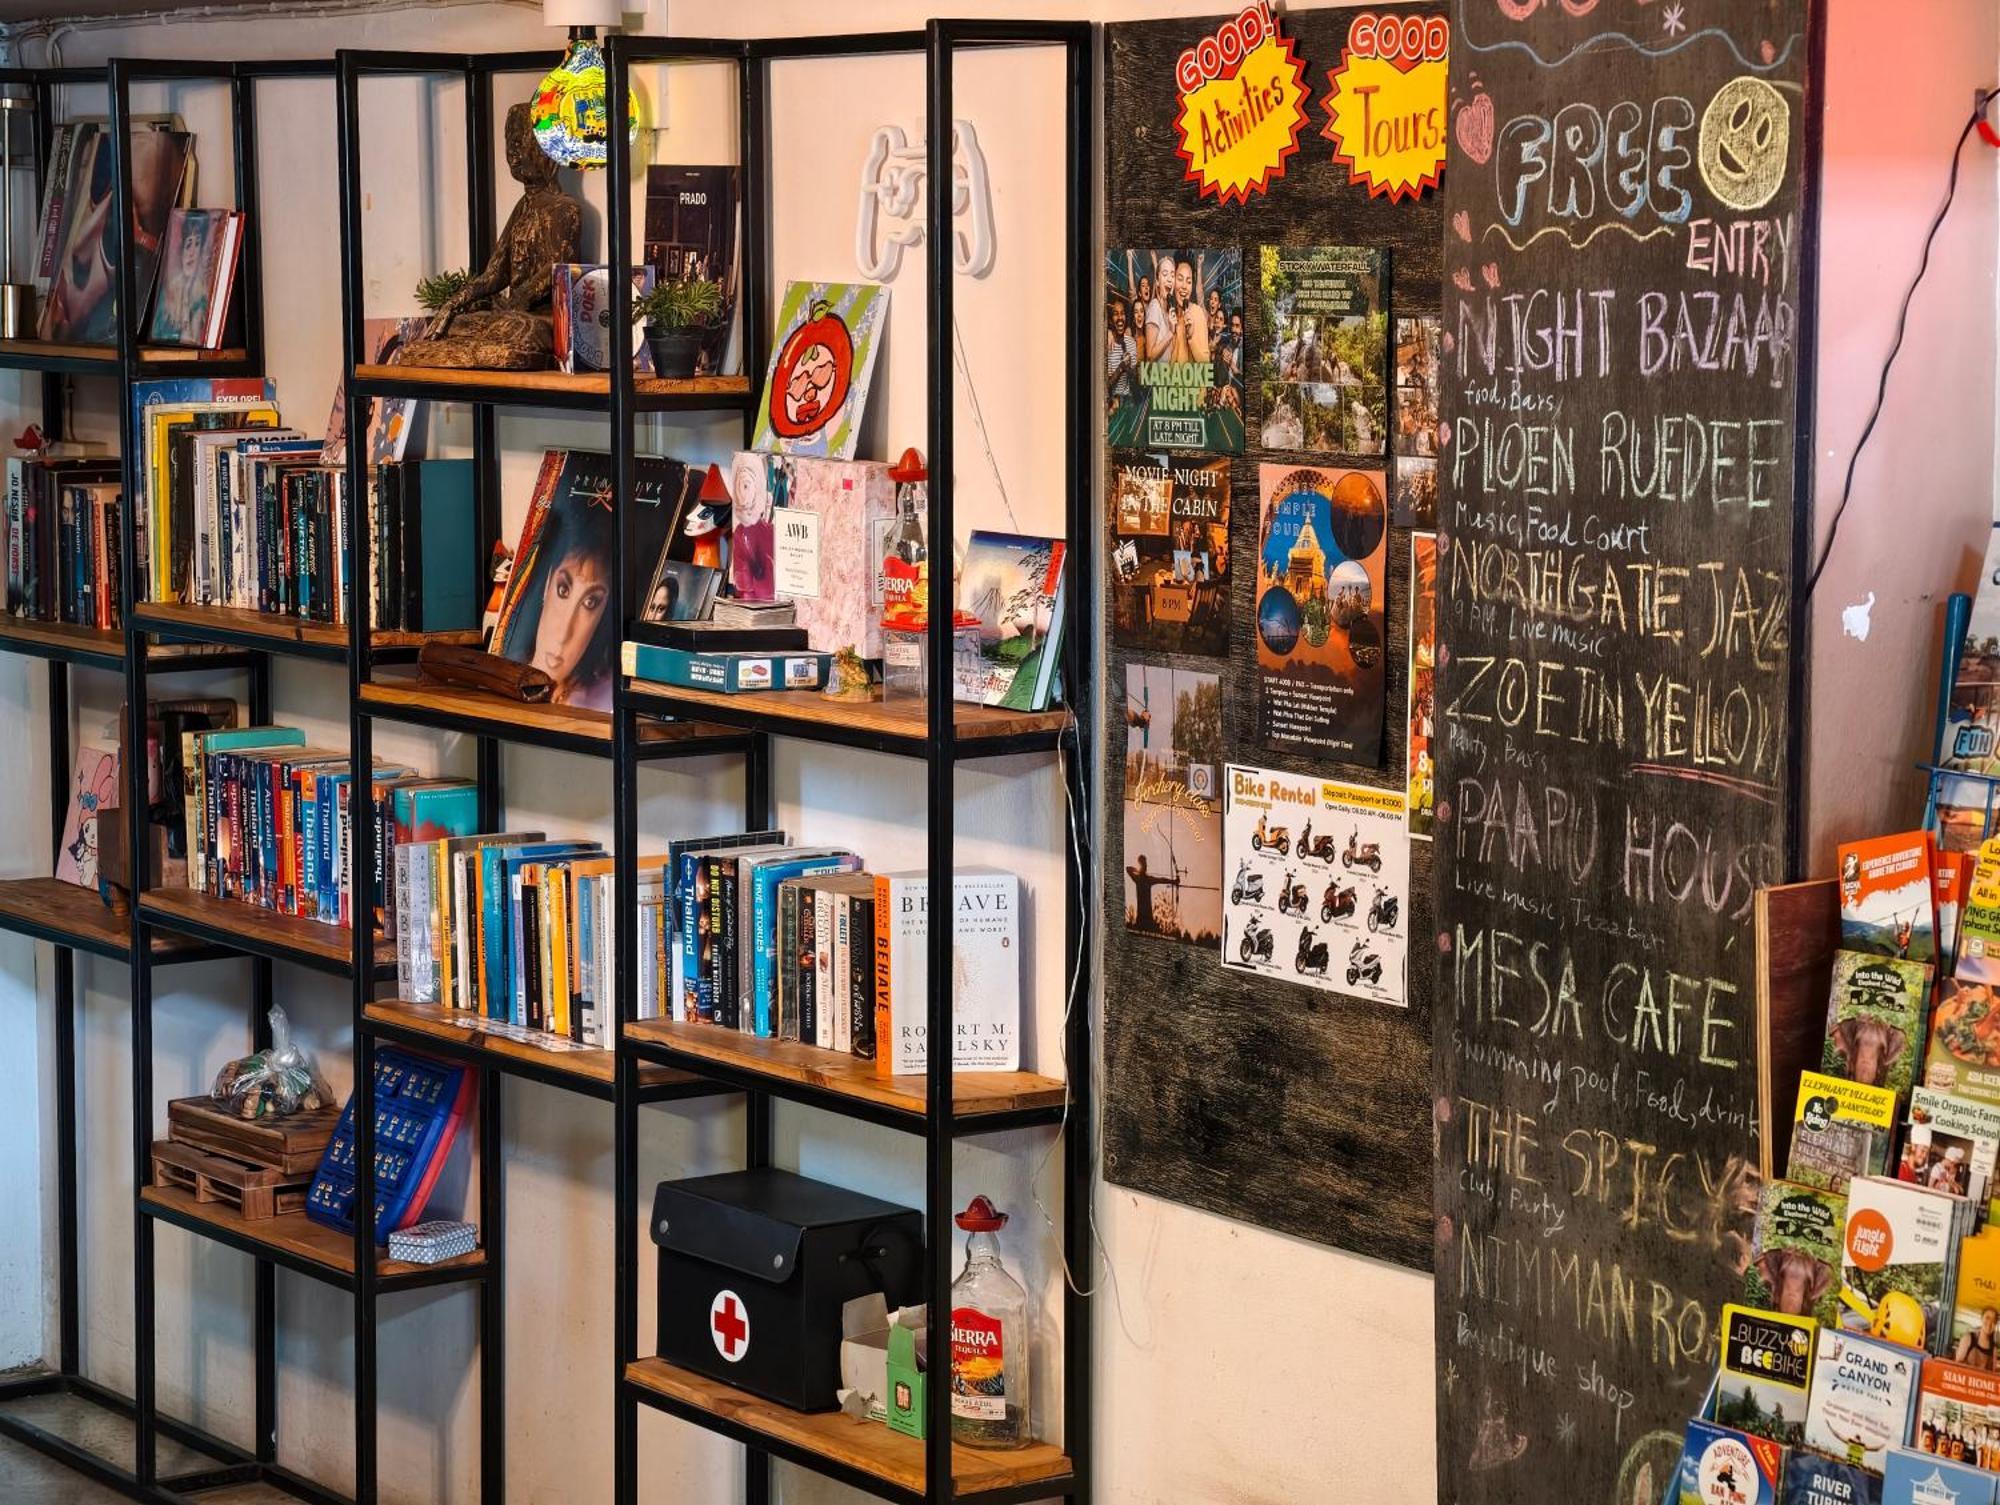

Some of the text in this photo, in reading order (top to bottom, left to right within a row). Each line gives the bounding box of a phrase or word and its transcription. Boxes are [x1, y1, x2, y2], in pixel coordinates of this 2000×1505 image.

[1175, 1, 1274, 94] GOOD!
[1349, 14, 1449, 60] GOOD
[1200, 75, 1284, 164] Activities
[1496, 96, 1695, 226] FREE
[679, 191, 707, 205] PRADO
[1687, 212, 1793, 294] ENTRY
[1279, 261, 1370, 272] STICKY WATERFALL
[1456, 288, 1615, 382] NIGHT
[1140, 362, 1214, 387] KARAOKE
[1152, 388, 1200, 411] NIGHT
[1152, 419, 1163, 432] AT
[1171, 420, 1184, 432] PM
[1186, 421, 1200, 434] TILL
[1154, 431, 1200, 445] LATE NIGHT
[1453, 410, 1784, 507] PLOEN RUEDEE
[11, 472, 19, 486] JO
[1125, 465, 1217, 487] MOVIE NIGHT
[1172, 498, 1218, 517] CABIN
[785, 522, 808, 540] AWB
[1446, 656, 1565, 736] ZOE
[1958, 728, 1990, 752] FUN
[1234, 773, 1265, 799] Bike
[1269, 781, 1316, 808] Rental
[208, 779, 216, 842] Thailand
[306, 808, 316, 884] Thailand
[340, 814, 348, 888] Thailand
[710, 865, 721, 933] DO NOT DISTURB
[901, 893, 1008, 914] BEAVE
[685, 885, 694, 955] Thailand
[755, 877, 764, 952] TRUE STORIES
[839, 914, 847, 945] FOLLETT
[877, 937, 888, 1014] BEHAVE
[1456, 923, 1583, 1041] MESA
[902, 1023, 981, 1038] RORT
[904, 1039, 1008, 1054] SALSKY
[1803, 1079, 1848, 1096] ELEPHANT
[1915, 1093, 1939, 1108] Smile
[1941, 1100, 1977, 1118] Organic
[1936, 1115, 2000, 1140] Cooking School
[1649, 1281, 1722, 1369] RO
[1738, 1323, 1789, 1350] BUZZY
[1846, 1352, 1888, 1376] GRAND
[1838, 1366, 1891, 1393] CANYON
[1943, 1371, 1996, 1392] SIAM HOME
[1806, 1491, 1851, 1505] TUBIN
[1813, 1474, 1852, 1500] RIVER
